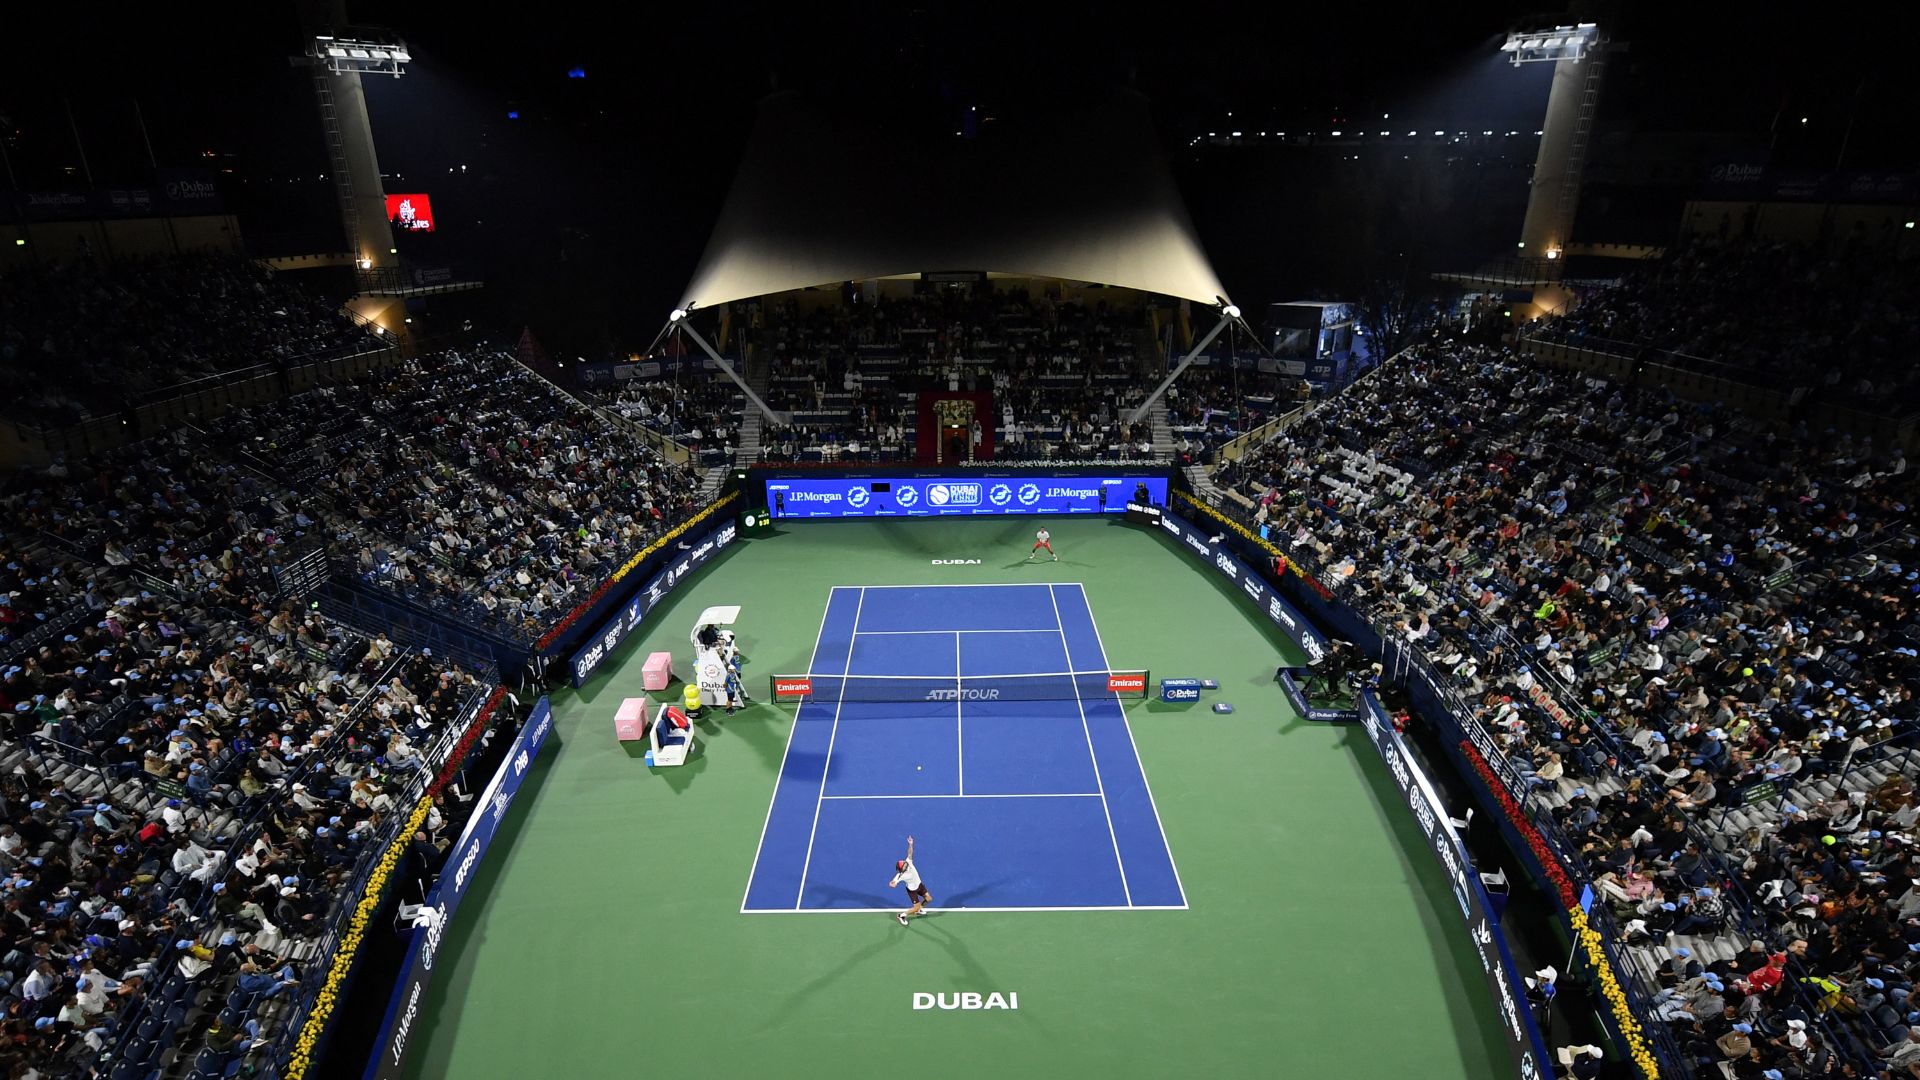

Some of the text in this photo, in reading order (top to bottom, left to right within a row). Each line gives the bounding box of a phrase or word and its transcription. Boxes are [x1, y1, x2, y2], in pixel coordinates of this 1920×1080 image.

[950, 485, 978, 493] DUBAI
[1045, 487, 1098, 500] J.P.Morgan
[789, 492, 842, 504] J.P.Morgan
[584, 644, 603, 664] Dubai
[777, 683, 809, 692] Emirates
[1110, 679, 1143, 687] Emirates
[960, 688, 1000, 700] TOUR
[1416, 801, 1435, 834] DUBAI
[455, 838, 480, 893] ATP500
[912, 991, 1019, 1010] DUBAI
[392, 981, 421, 1066] J.P.Morgan
